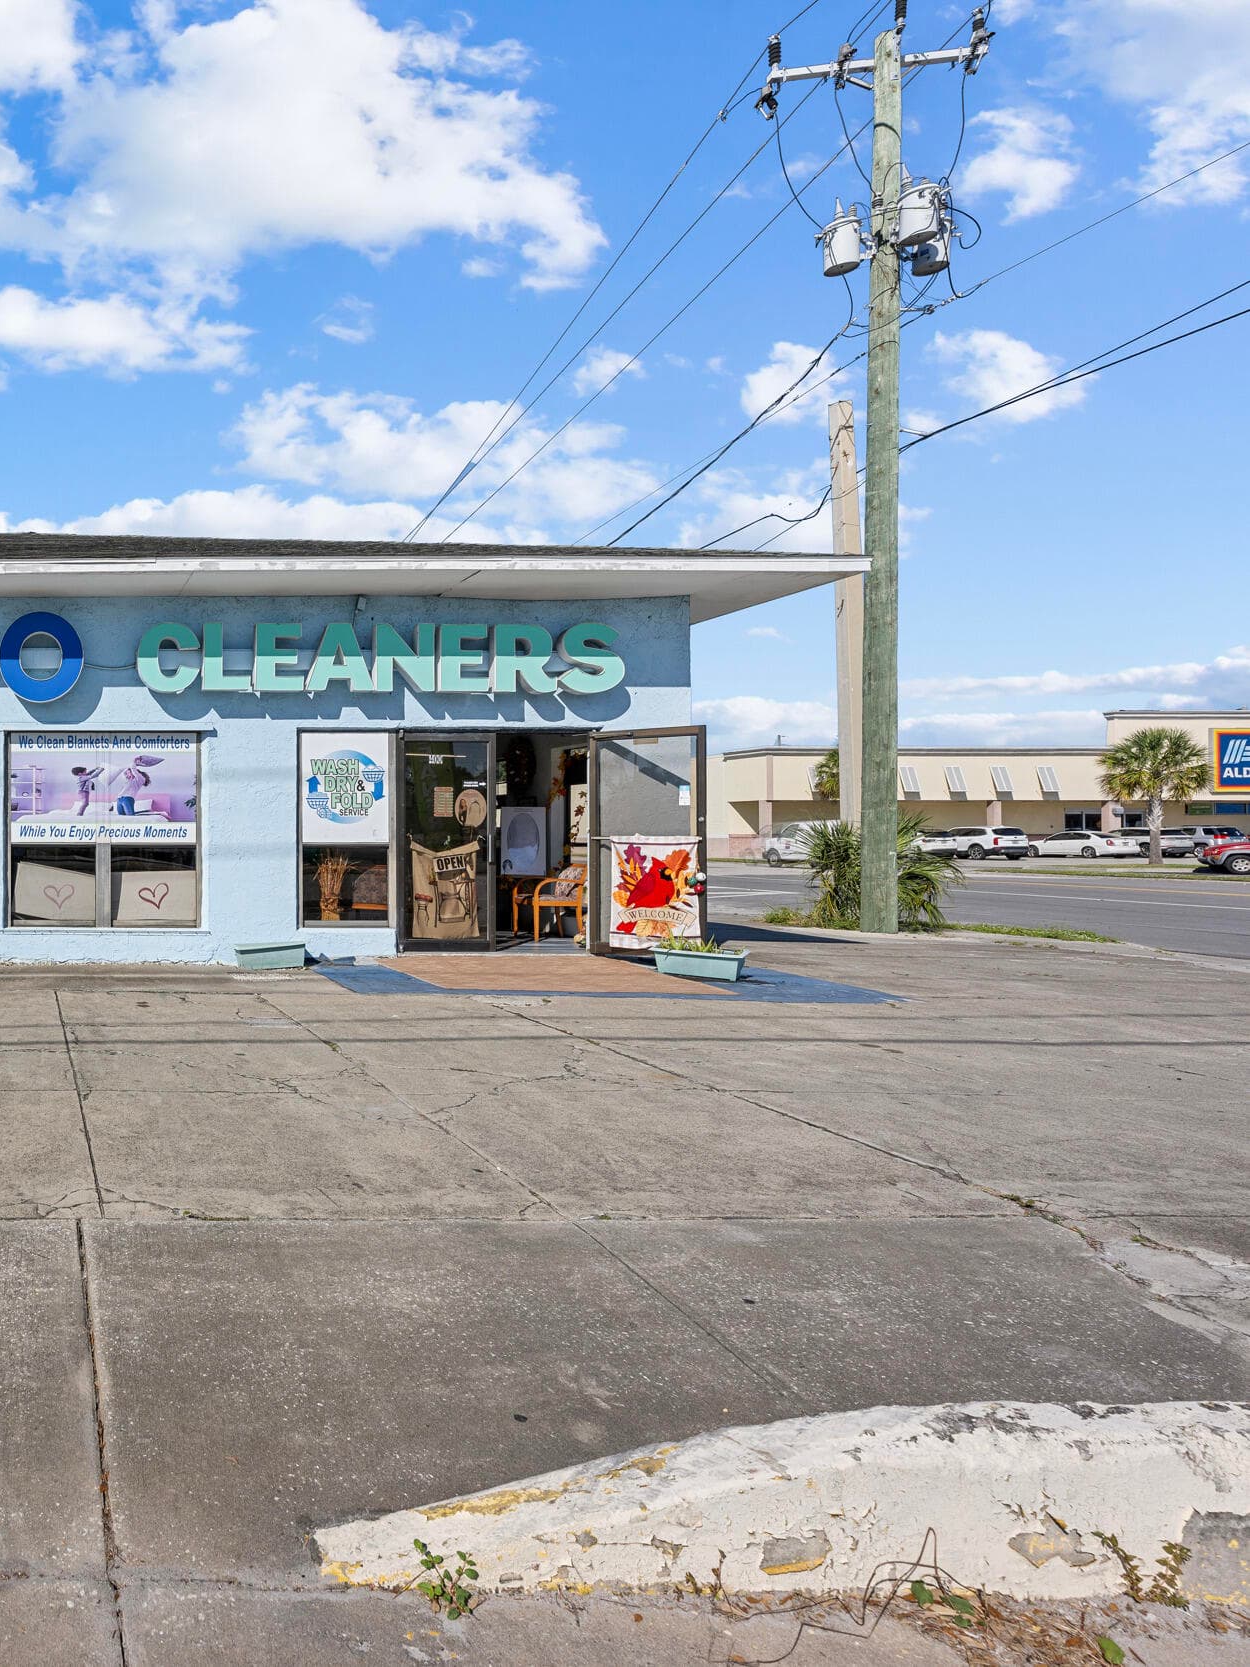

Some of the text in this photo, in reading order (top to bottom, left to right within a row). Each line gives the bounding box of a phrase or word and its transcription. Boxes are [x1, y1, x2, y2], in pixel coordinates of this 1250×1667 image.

[136, 622, 625, 695] CLEANERS
[18, 735, 190, 749] We Clean Blankets And Comforters
[310, 758, 359, 775] WASH
[324, 776, 365, 792] DRY &
[330, 792, 373, 809] FOLD
[339, 808, 369, 817] SERVICE
[19, 825, 188, 840] While You Enjoy Precious Moments
[437, 856, 464, 870] OPEN
[628, 909, 684, 921] WELCOME
